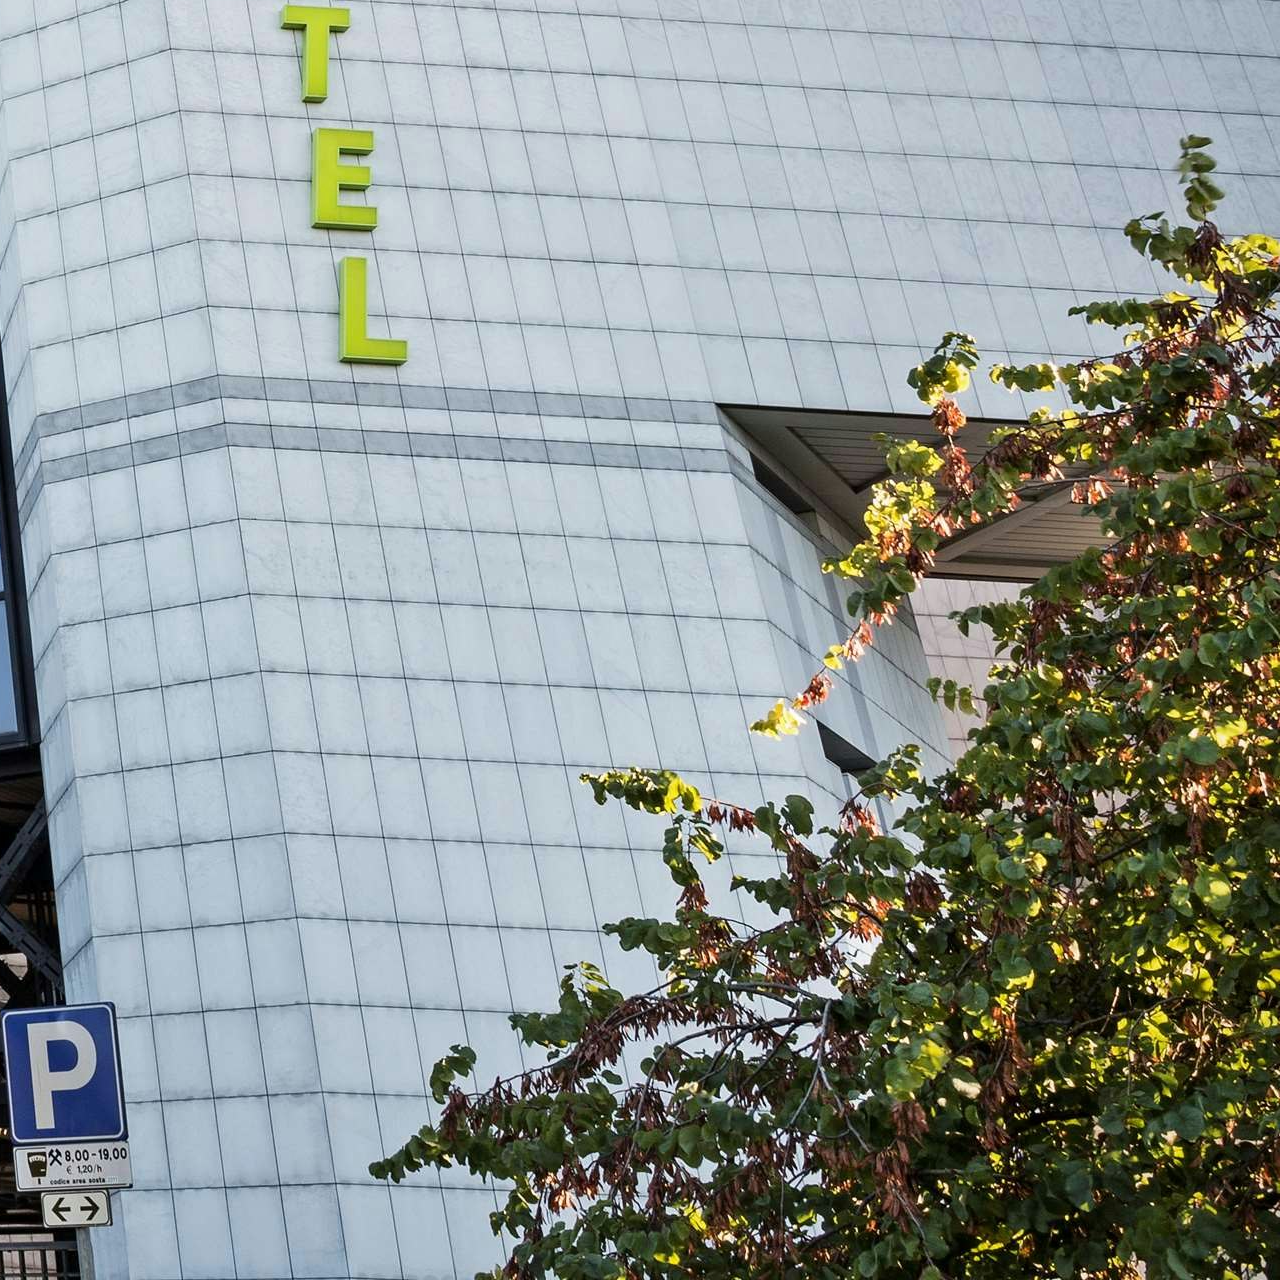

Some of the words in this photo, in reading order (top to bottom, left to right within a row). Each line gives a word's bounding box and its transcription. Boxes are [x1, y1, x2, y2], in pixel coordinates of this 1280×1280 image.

[27, 1020, 97, 1130] P
[66, 1165, 73, 1175] €
[49, 1177, 71, 1185] codice
[72, 1177, 87, 1185] area
[88, 1176, 106, 1184] sosta
